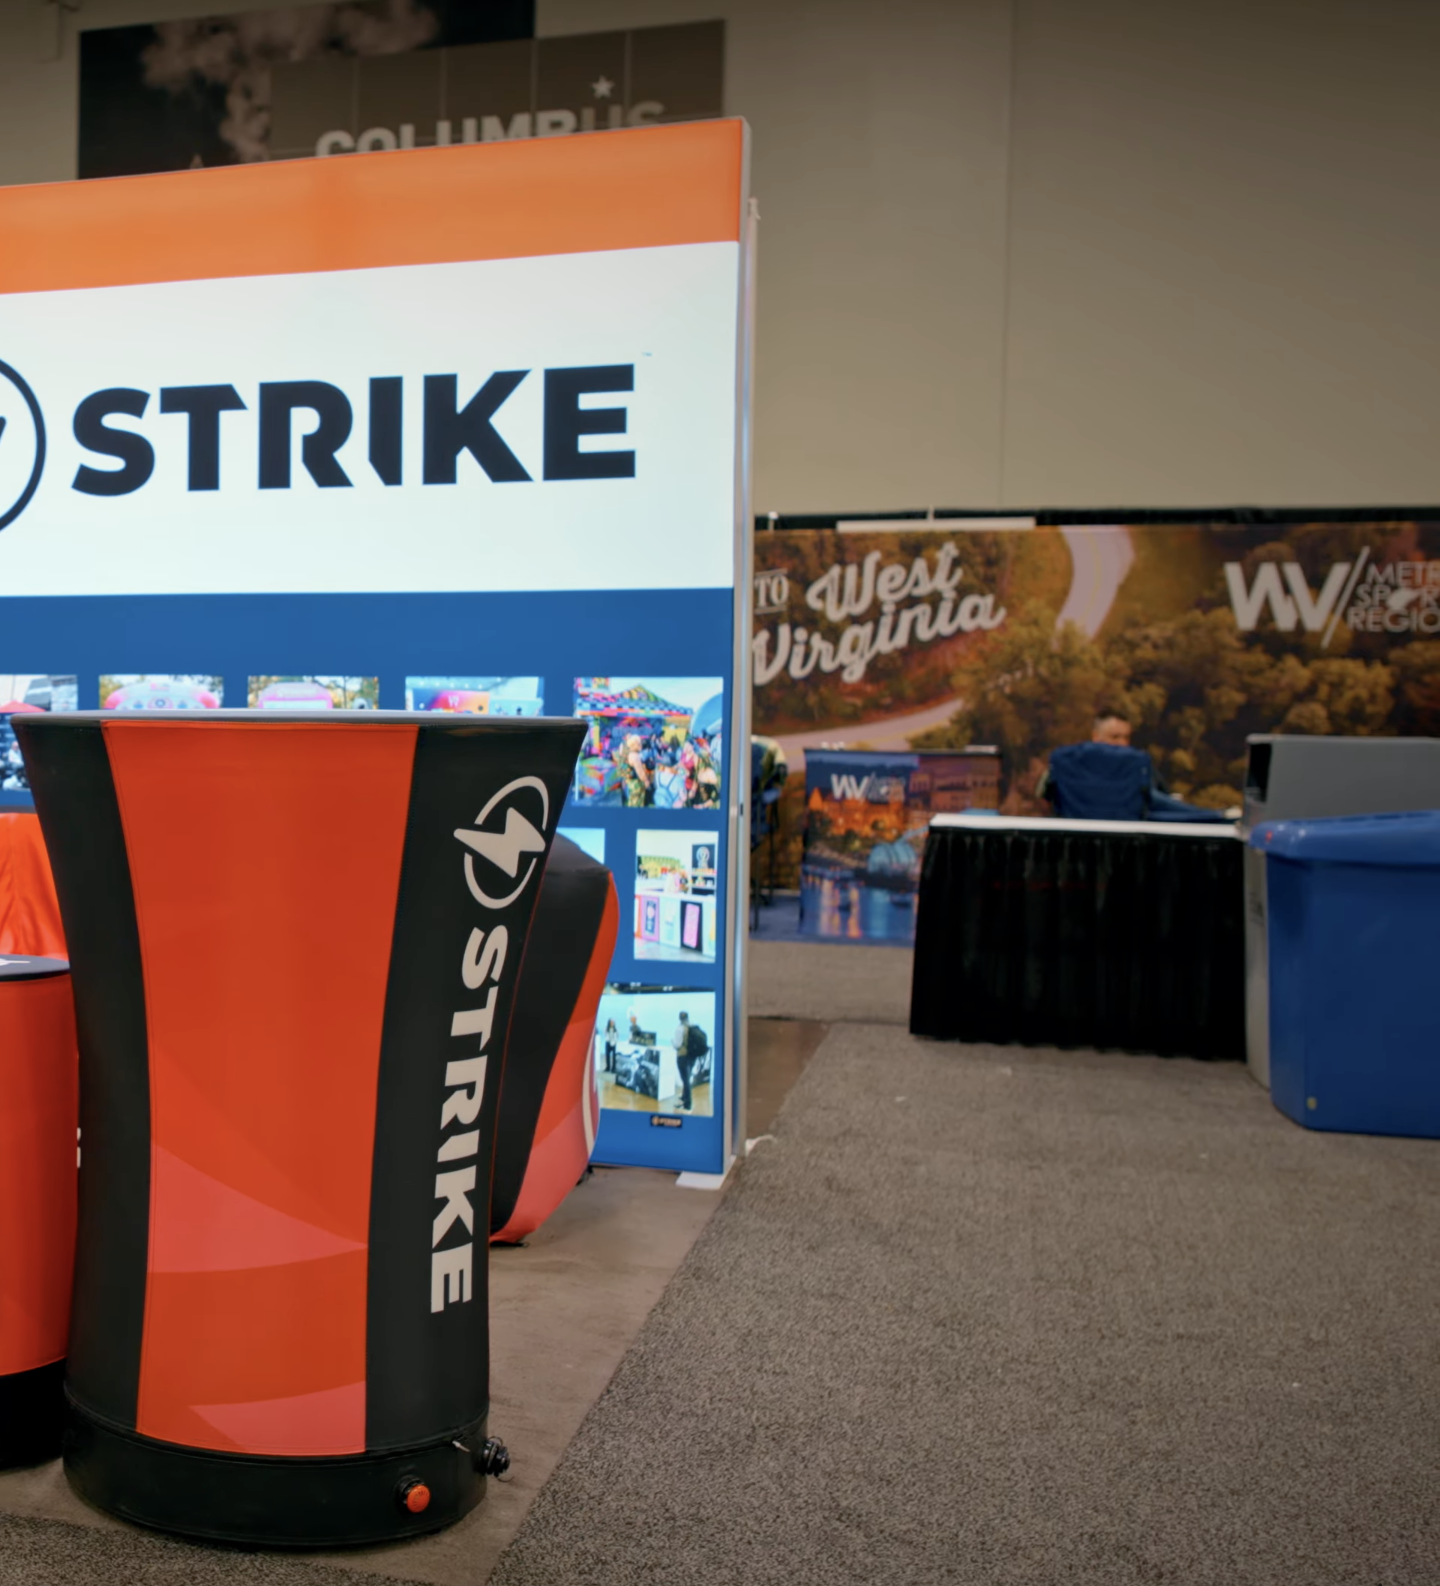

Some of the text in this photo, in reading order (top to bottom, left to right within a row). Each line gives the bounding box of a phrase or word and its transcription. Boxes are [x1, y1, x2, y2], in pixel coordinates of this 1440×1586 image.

[71, 363, 636, 497] STRIKE
[754, 541, 963, 622] TO West
[752, 594, 1007, 686] Virginia
[431, 925, 508, 1313] STRIKE
